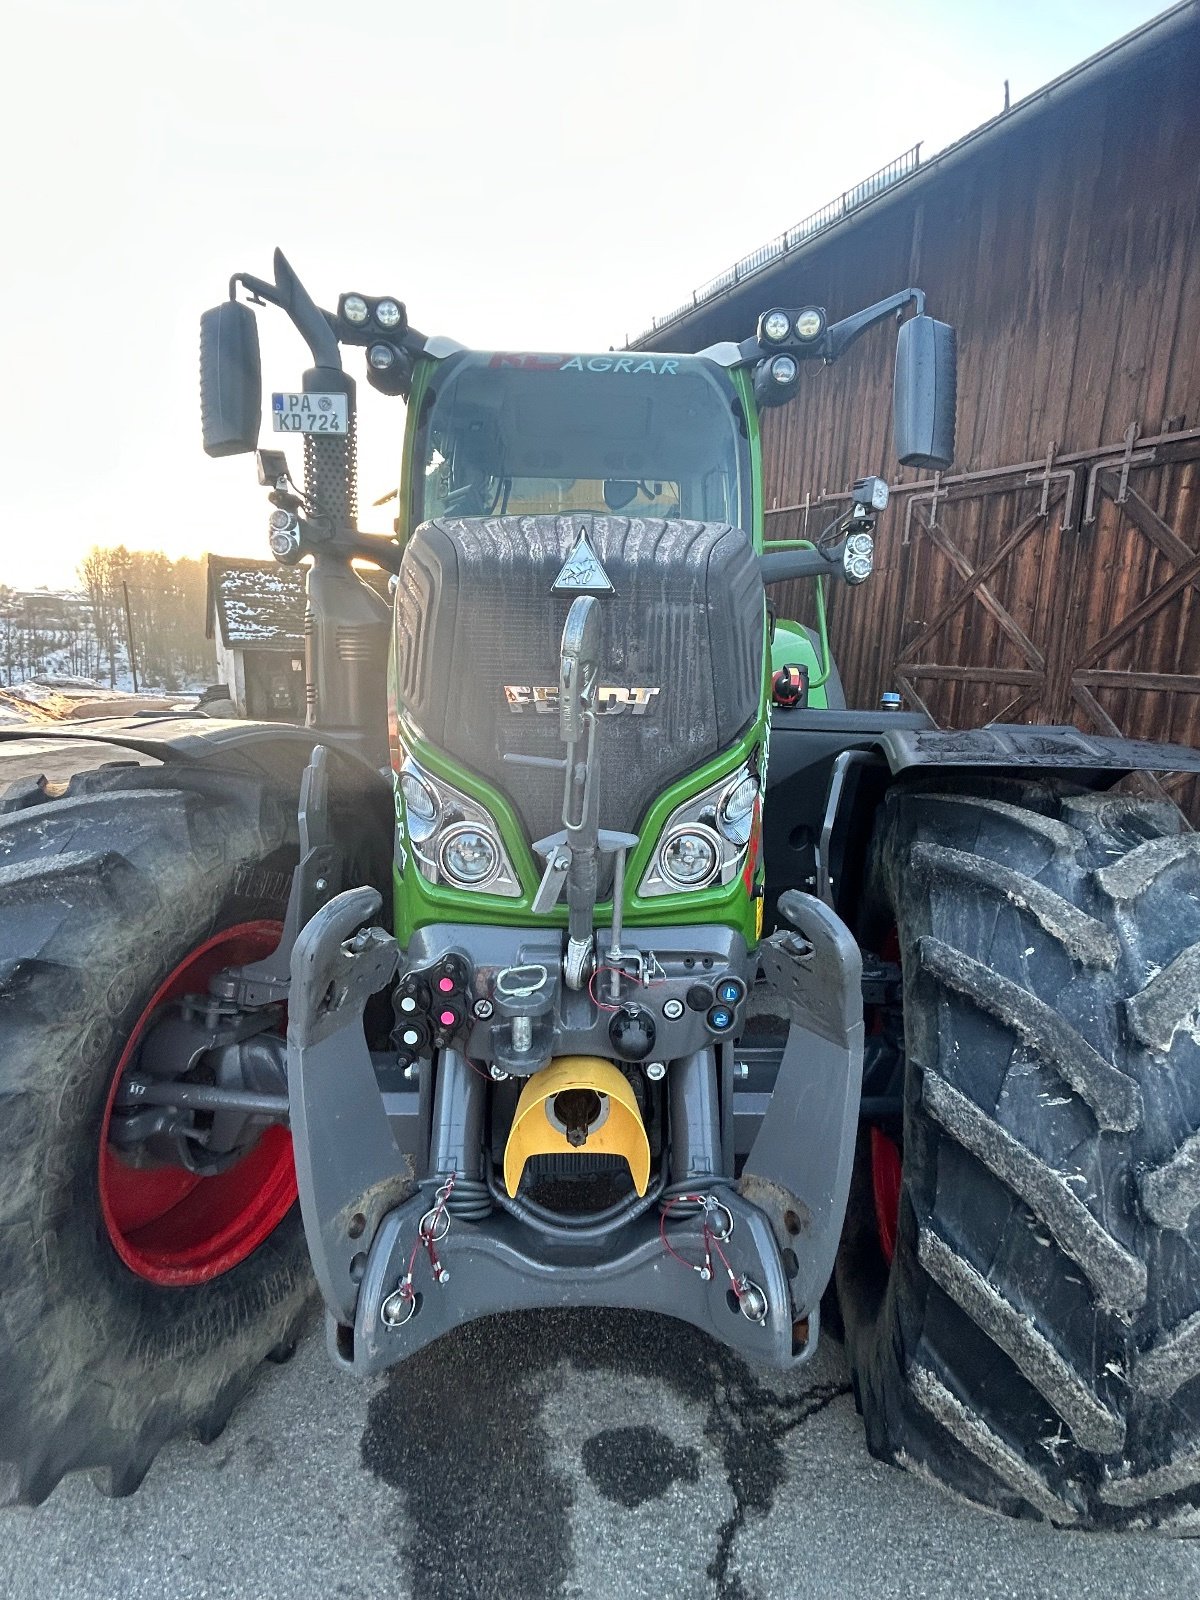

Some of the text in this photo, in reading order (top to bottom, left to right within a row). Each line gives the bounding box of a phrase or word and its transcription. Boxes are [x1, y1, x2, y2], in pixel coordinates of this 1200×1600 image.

[560, 356, 680, 375] AGRAR
[288, 395, 312, 412] PA
[279, 413, 340, 431] KD 724
[503, 685, 660, 715] FEDT
